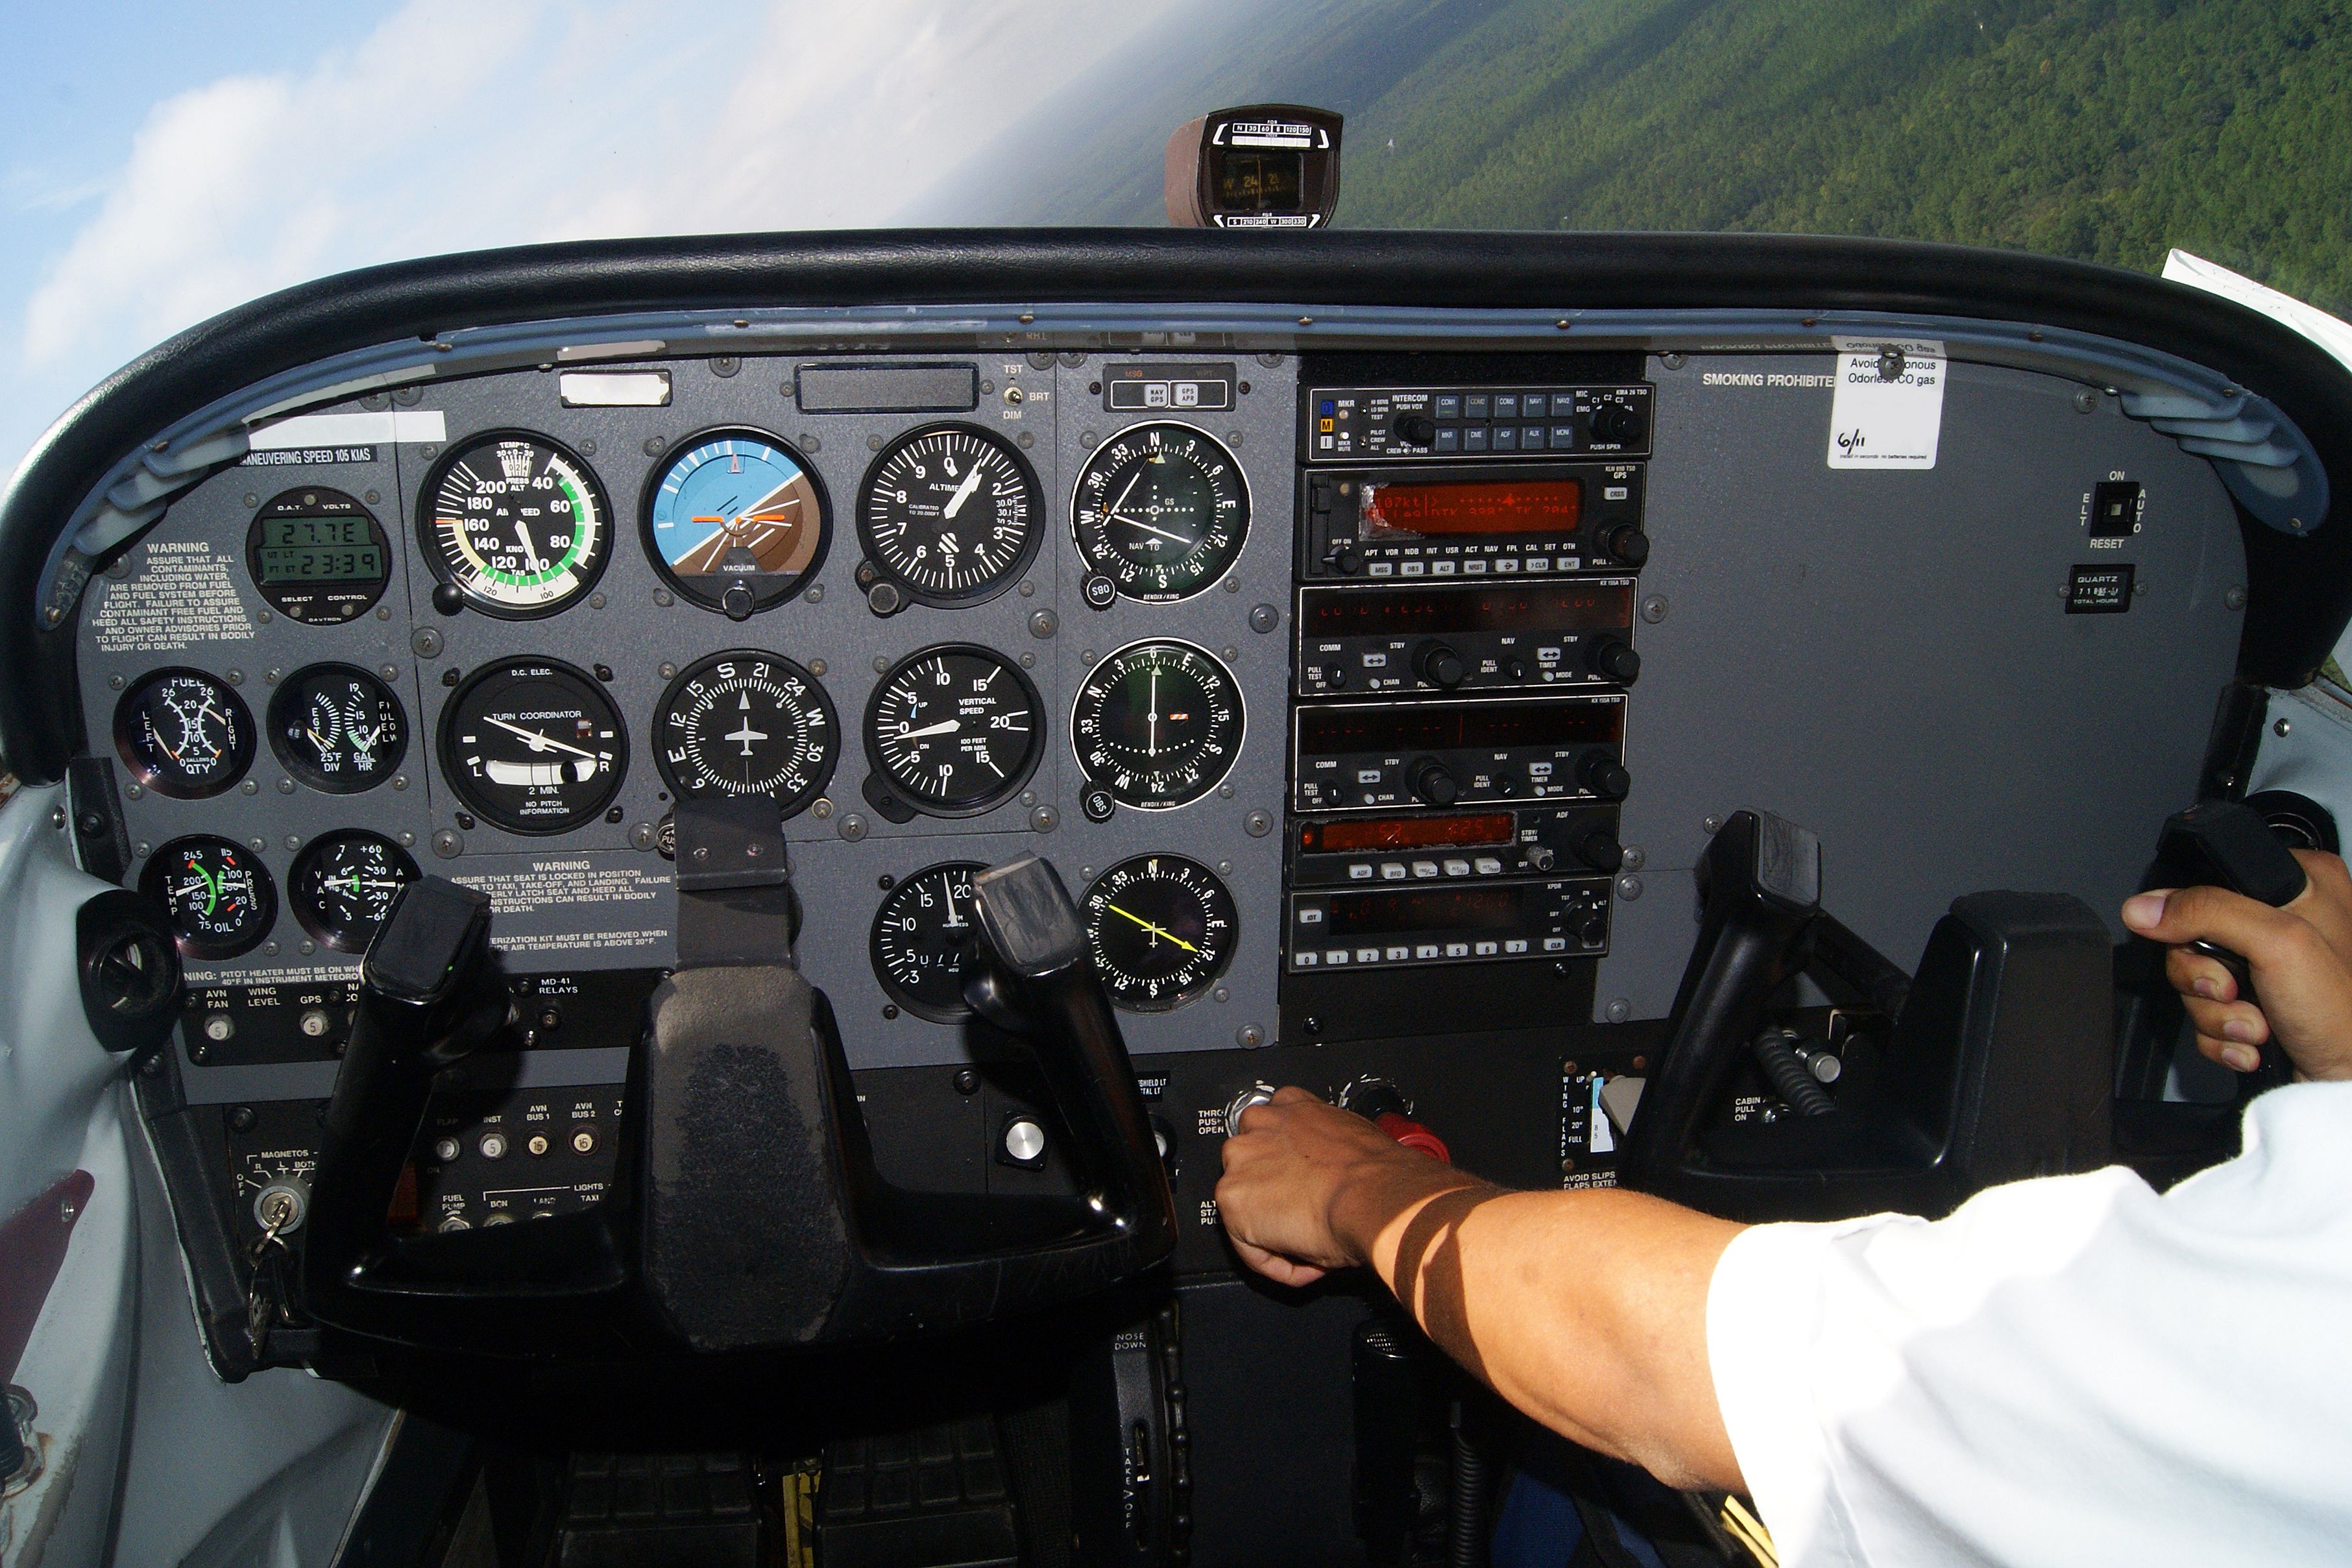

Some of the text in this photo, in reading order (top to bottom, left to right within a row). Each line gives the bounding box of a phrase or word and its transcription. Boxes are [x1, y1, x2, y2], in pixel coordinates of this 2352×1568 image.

[1850, 357, 1880, 369] Avoid
[1004, 365, 1023, 374] TST
[1703, 373, 1837, 388] SMOKING PROHIBITE
[1897, 372, 1935, 387] CO gas
[1030, 392, 1050, 401] BRT
[1003, 411, 1021, 419] DIM
[1837, 428, 1865, 455] 6/11
[240, 448, 370, 465] ANEUVERING SPEED 105 KIAS
[2109, 471, 2125, 481] ON
[476, 481, 506, 494] 200
[532, 477, 553, 490] 40
[467, 497, 492, 510] 180
[550, 500, 570, 513] 60
[465, 518, 489, 531] 160
[474, 537, 500, 550] 140
[550, 535, 570, 548] 80
[2090, 539, 2124, 548] RESET
[147, 542, 209, 553] WARNING
[300, 553, 374, 575] 23:39
[491, 556, 516, 569] 120
[723, 564, 755, 572] VACUUM
[140, 573, 192, 582] INCLUDING
[131, 583, 176, 591] REMOVED
[104, 601, 140, 609] FLIGHT.
[203, 597, 240, 606] ASSURE
[92, 618, 116, 627] HEED
[139, 617, 175, 625] SAFETY
[177, 614, 247, 624] INSTRUCTIONS
[127, 625, 162, 634] OWNER
[165, 624, 221, 633] ADVISORIES
[112, 634, 145, 643] FLIGHT
[170, 633, 205, 641] RESULT
[221, 631, 254, 640] BODILY
[154, 642, 188, 650] DEATH.
[520, 710, 581, 719] COORDINATOR
[990, 716, 1010, 729] 20
[186, 764, 210, 774] QTY
[324, 763, 340, 771] DIV
[184, 850, 203, 860] 245
[533, 860, 590, 871] WARNING
[451, 876, 485, 884] ASSURE
[588, 878, 629, 886] LANDING.
[215, 923, 234, 932] OIL
[248, 998, 280, 1006] LEVEL
[300, 995, 322, 1004] GPS
[1736, 1097, 1760, 1105] CABIN
[1198, 1126, 1224, 1135] OPEN
[261, 1150, 309, 1158] MAGNETOS
[1564, 1171, 1615, 1182] AVOID SLIPS
[574, 1183, 603, 1191] LIGHTS
[1115, 1342, 1146, 1350] DOWN
